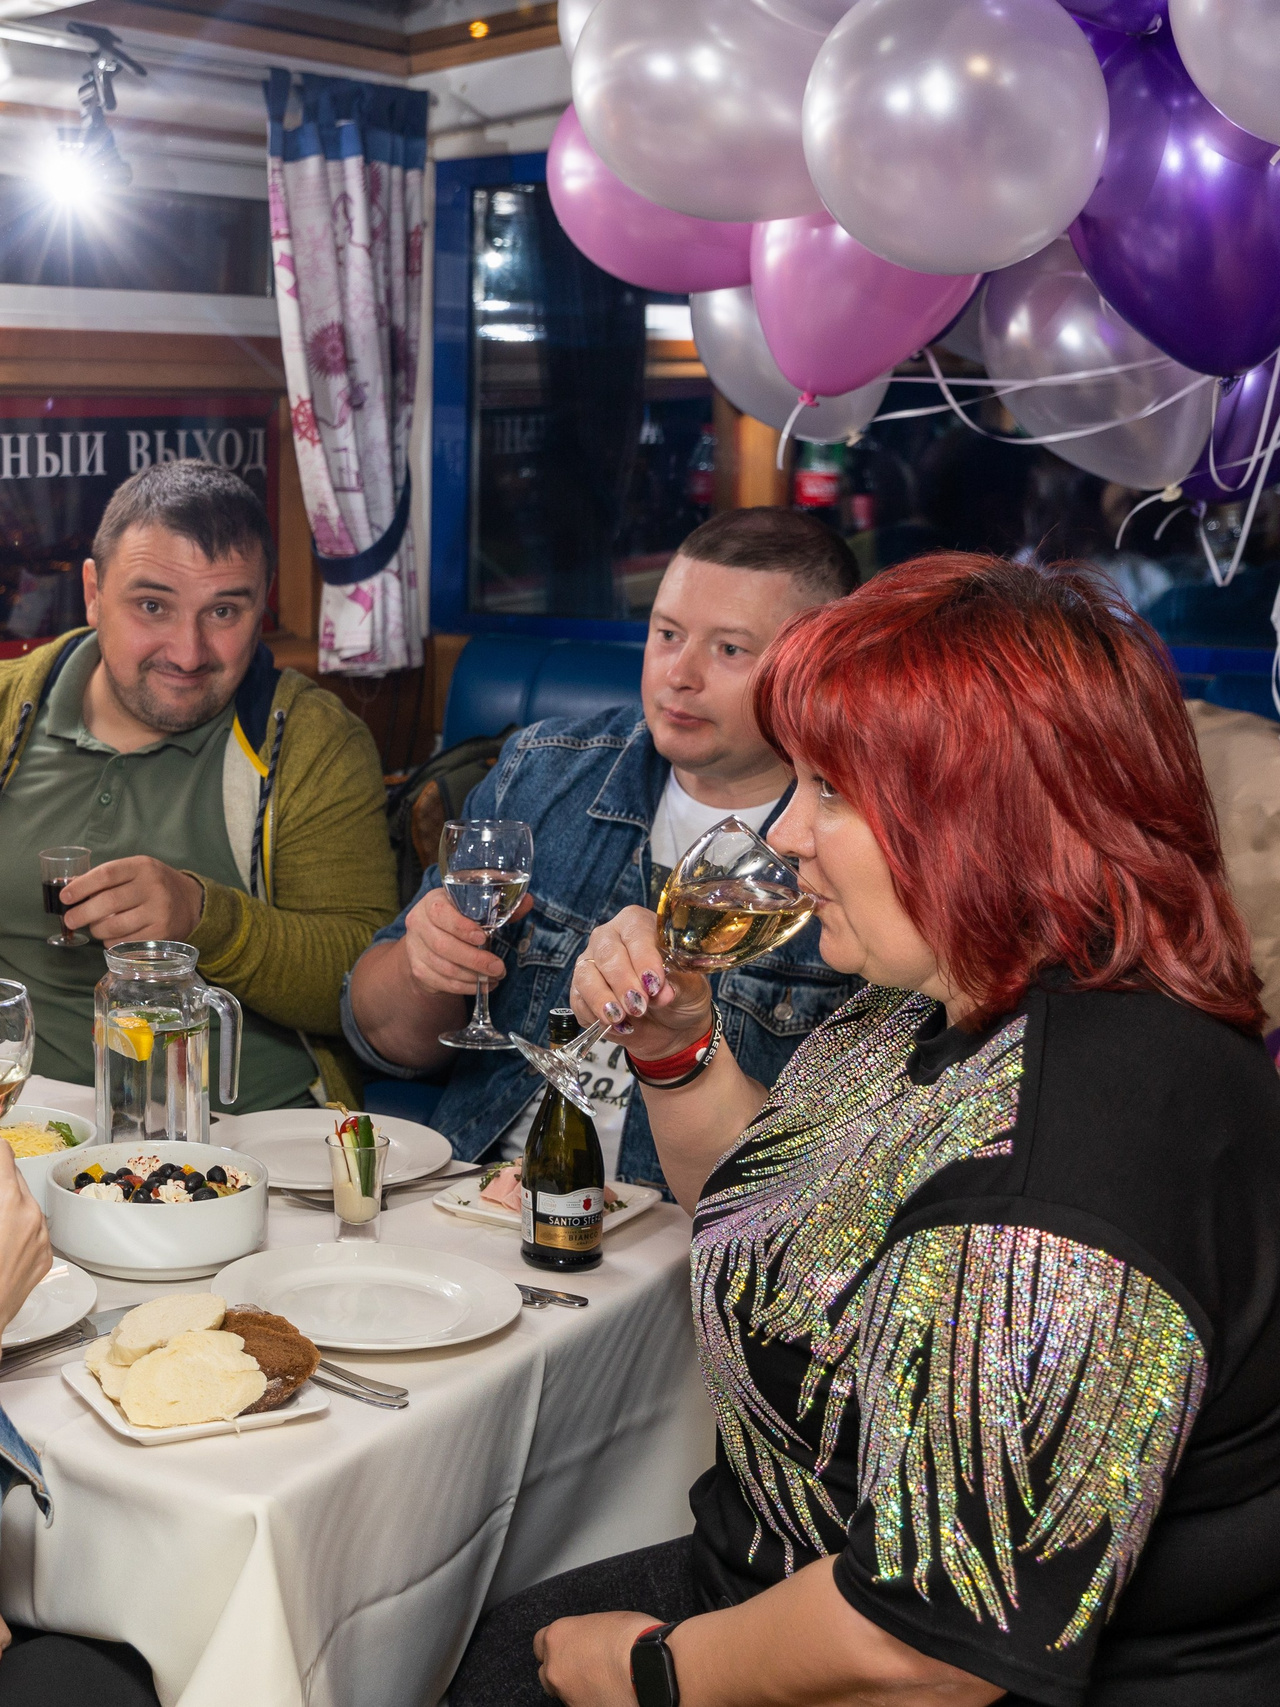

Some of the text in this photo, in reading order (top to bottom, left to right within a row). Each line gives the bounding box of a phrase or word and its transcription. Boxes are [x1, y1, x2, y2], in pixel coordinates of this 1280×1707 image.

[126, 428, 268, 478] ВЫХОД
[548, 1216, 581, 1227] SANTO
[568, 1231, 599, 1242] BIANCO
